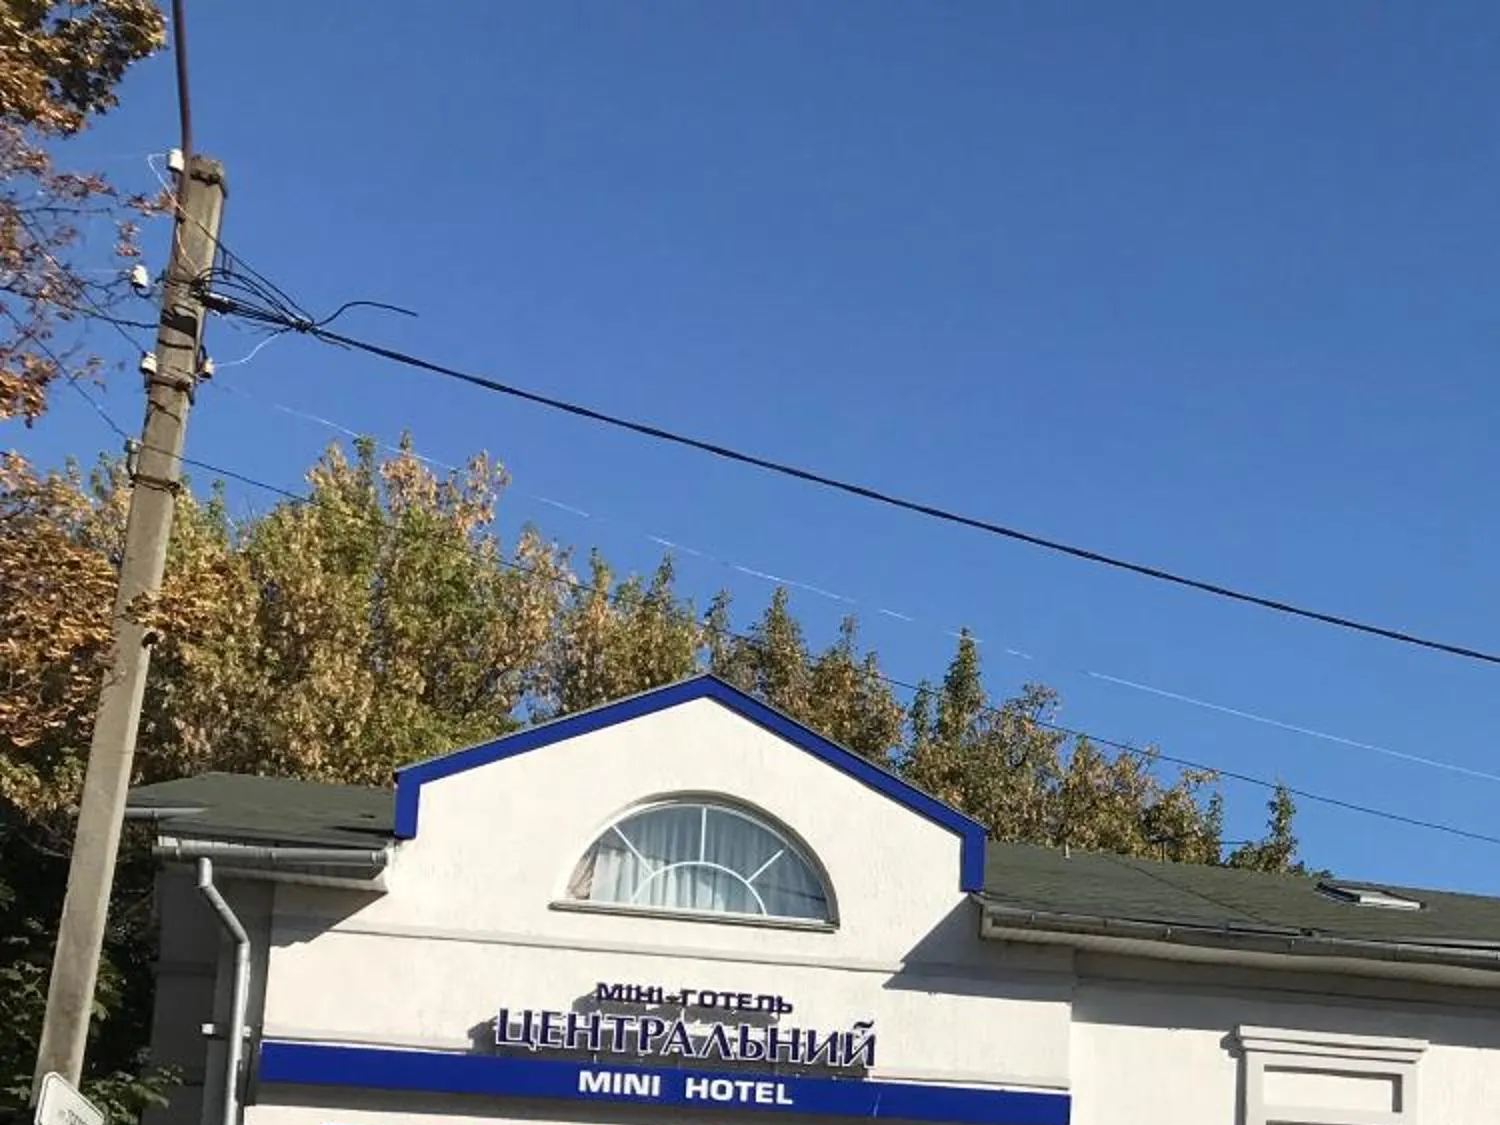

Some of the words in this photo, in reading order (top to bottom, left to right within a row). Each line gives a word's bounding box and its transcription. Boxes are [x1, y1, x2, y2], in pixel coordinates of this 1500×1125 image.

[596, 982, 793, 1014] МІНІ-ГОТЕЛЬ
[495, 1008, 877, 1068] ЦЕНТРАЛЬНИЙ
[578, 1071, 661, 1097] MINI
[685, 1077, 794, 1105] HOTEL
